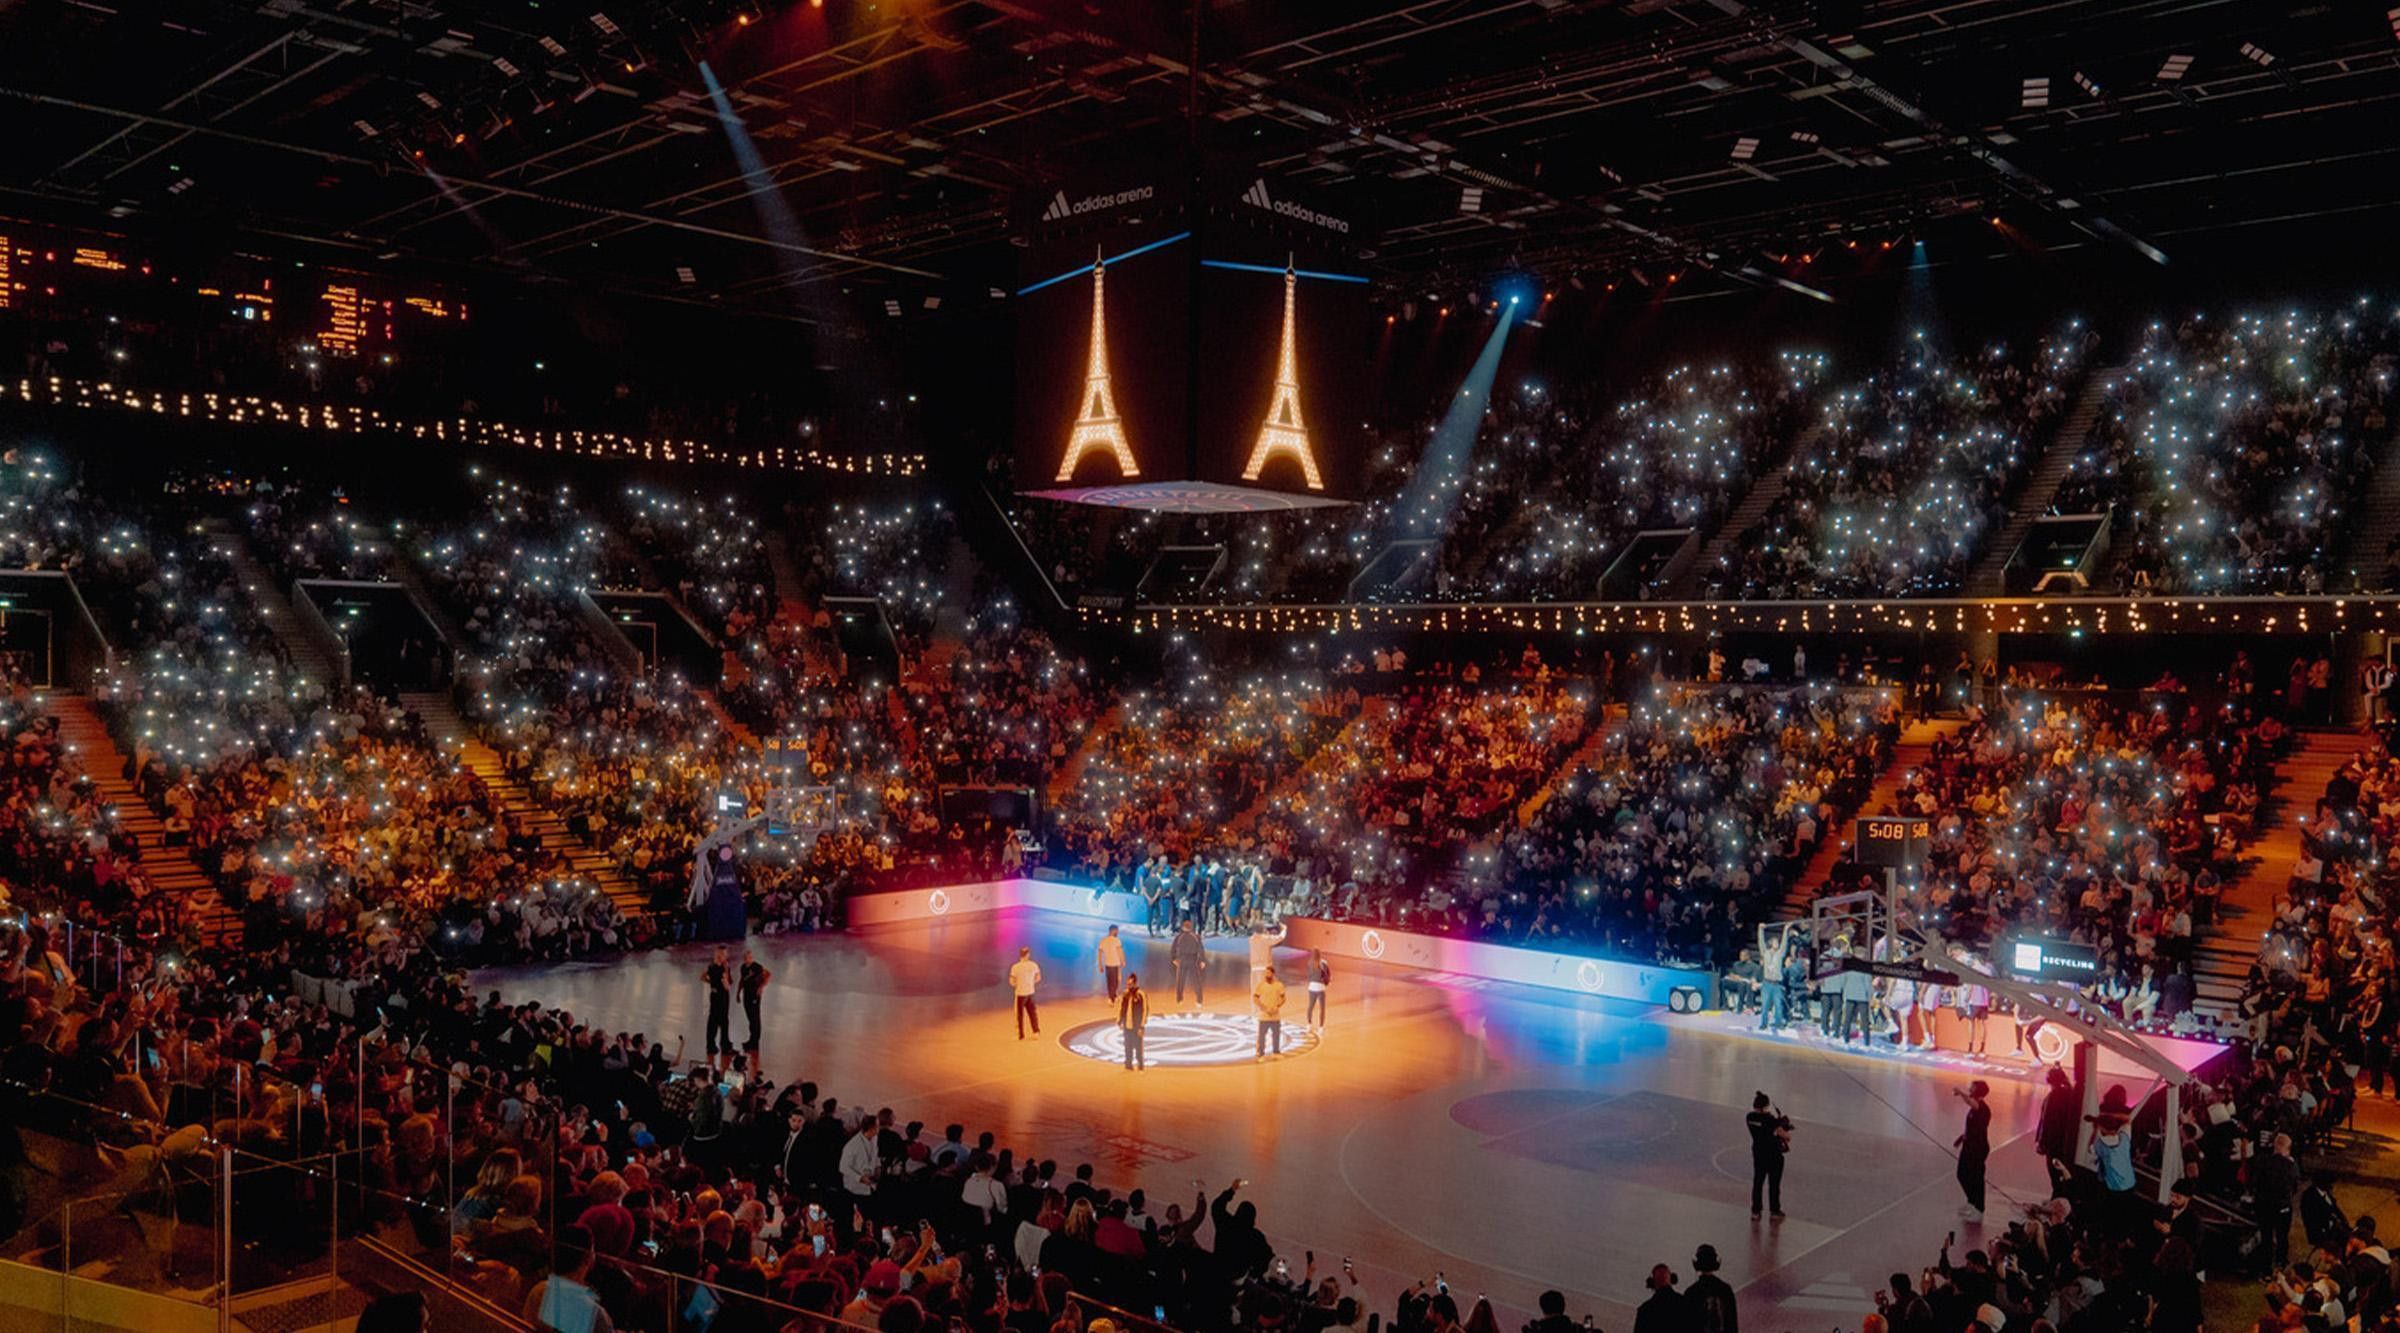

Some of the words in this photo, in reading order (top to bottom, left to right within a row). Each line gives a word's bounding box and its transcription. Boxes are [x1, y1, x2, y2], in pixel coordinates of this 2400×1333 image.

[1073, 194, 1115, 214] adidas
[1116, 186, 1153, 204] arena
[1274, 200, 1315, 223] adidas
[1315, 213, 1349, 233] arena
[2042, 956, 2095, 970] RECYCLING
